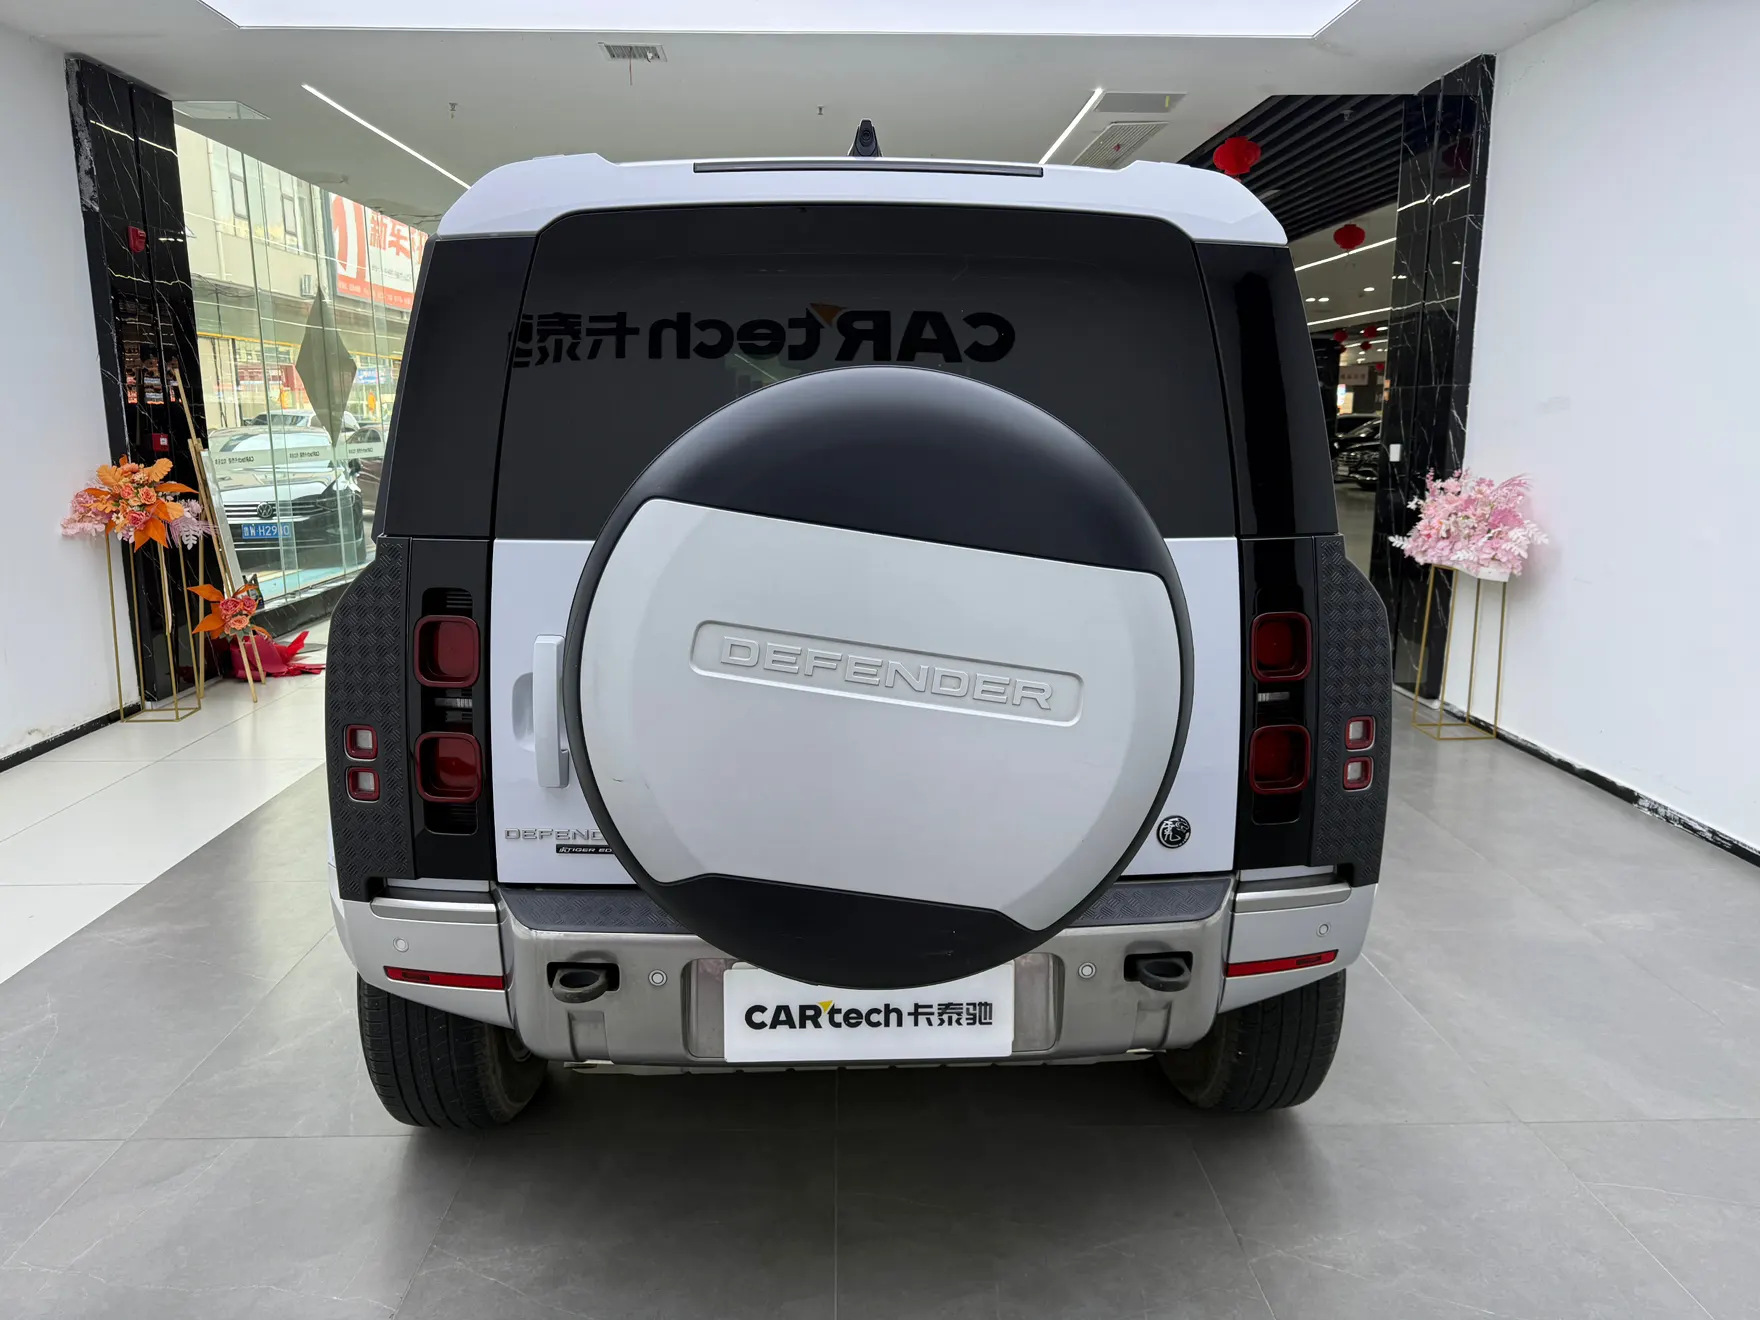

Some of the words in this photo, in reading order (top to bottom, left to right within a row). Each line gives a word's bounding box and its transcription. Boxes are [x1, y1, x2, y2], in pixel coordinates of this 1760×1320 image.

[720, 635, 1054, 711] DEFENDER
[907, 1002, 993, 1027] 卡泰驰
